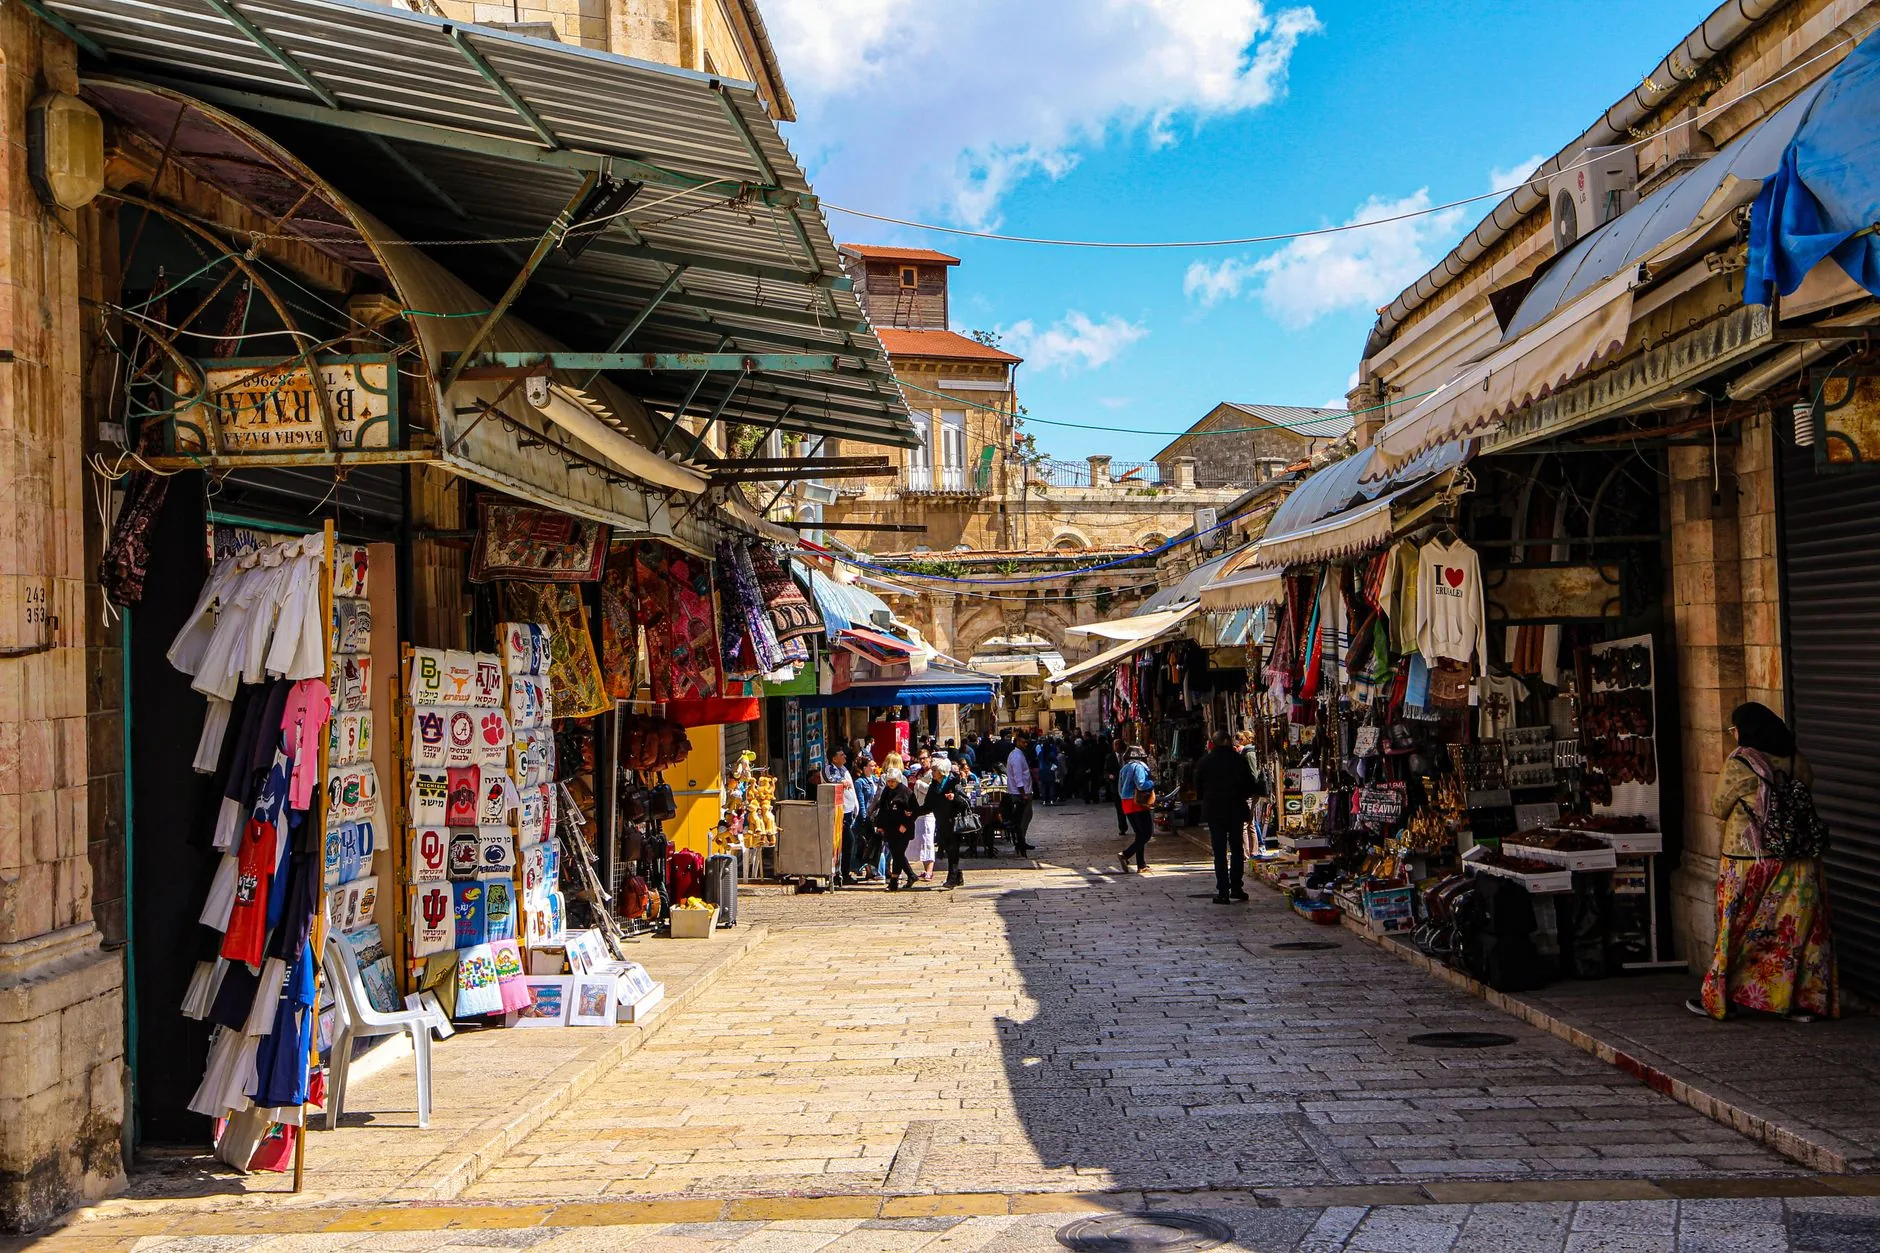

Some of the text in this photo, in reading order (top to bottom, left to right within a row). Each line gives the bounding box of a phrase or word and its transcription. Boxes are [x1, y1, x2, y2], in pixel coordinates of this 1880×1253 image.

[215, 389, 356, 425] BRAKAT
[223, 430, 270, 444] BAZAA
[420, 656, 441, 689] BU
